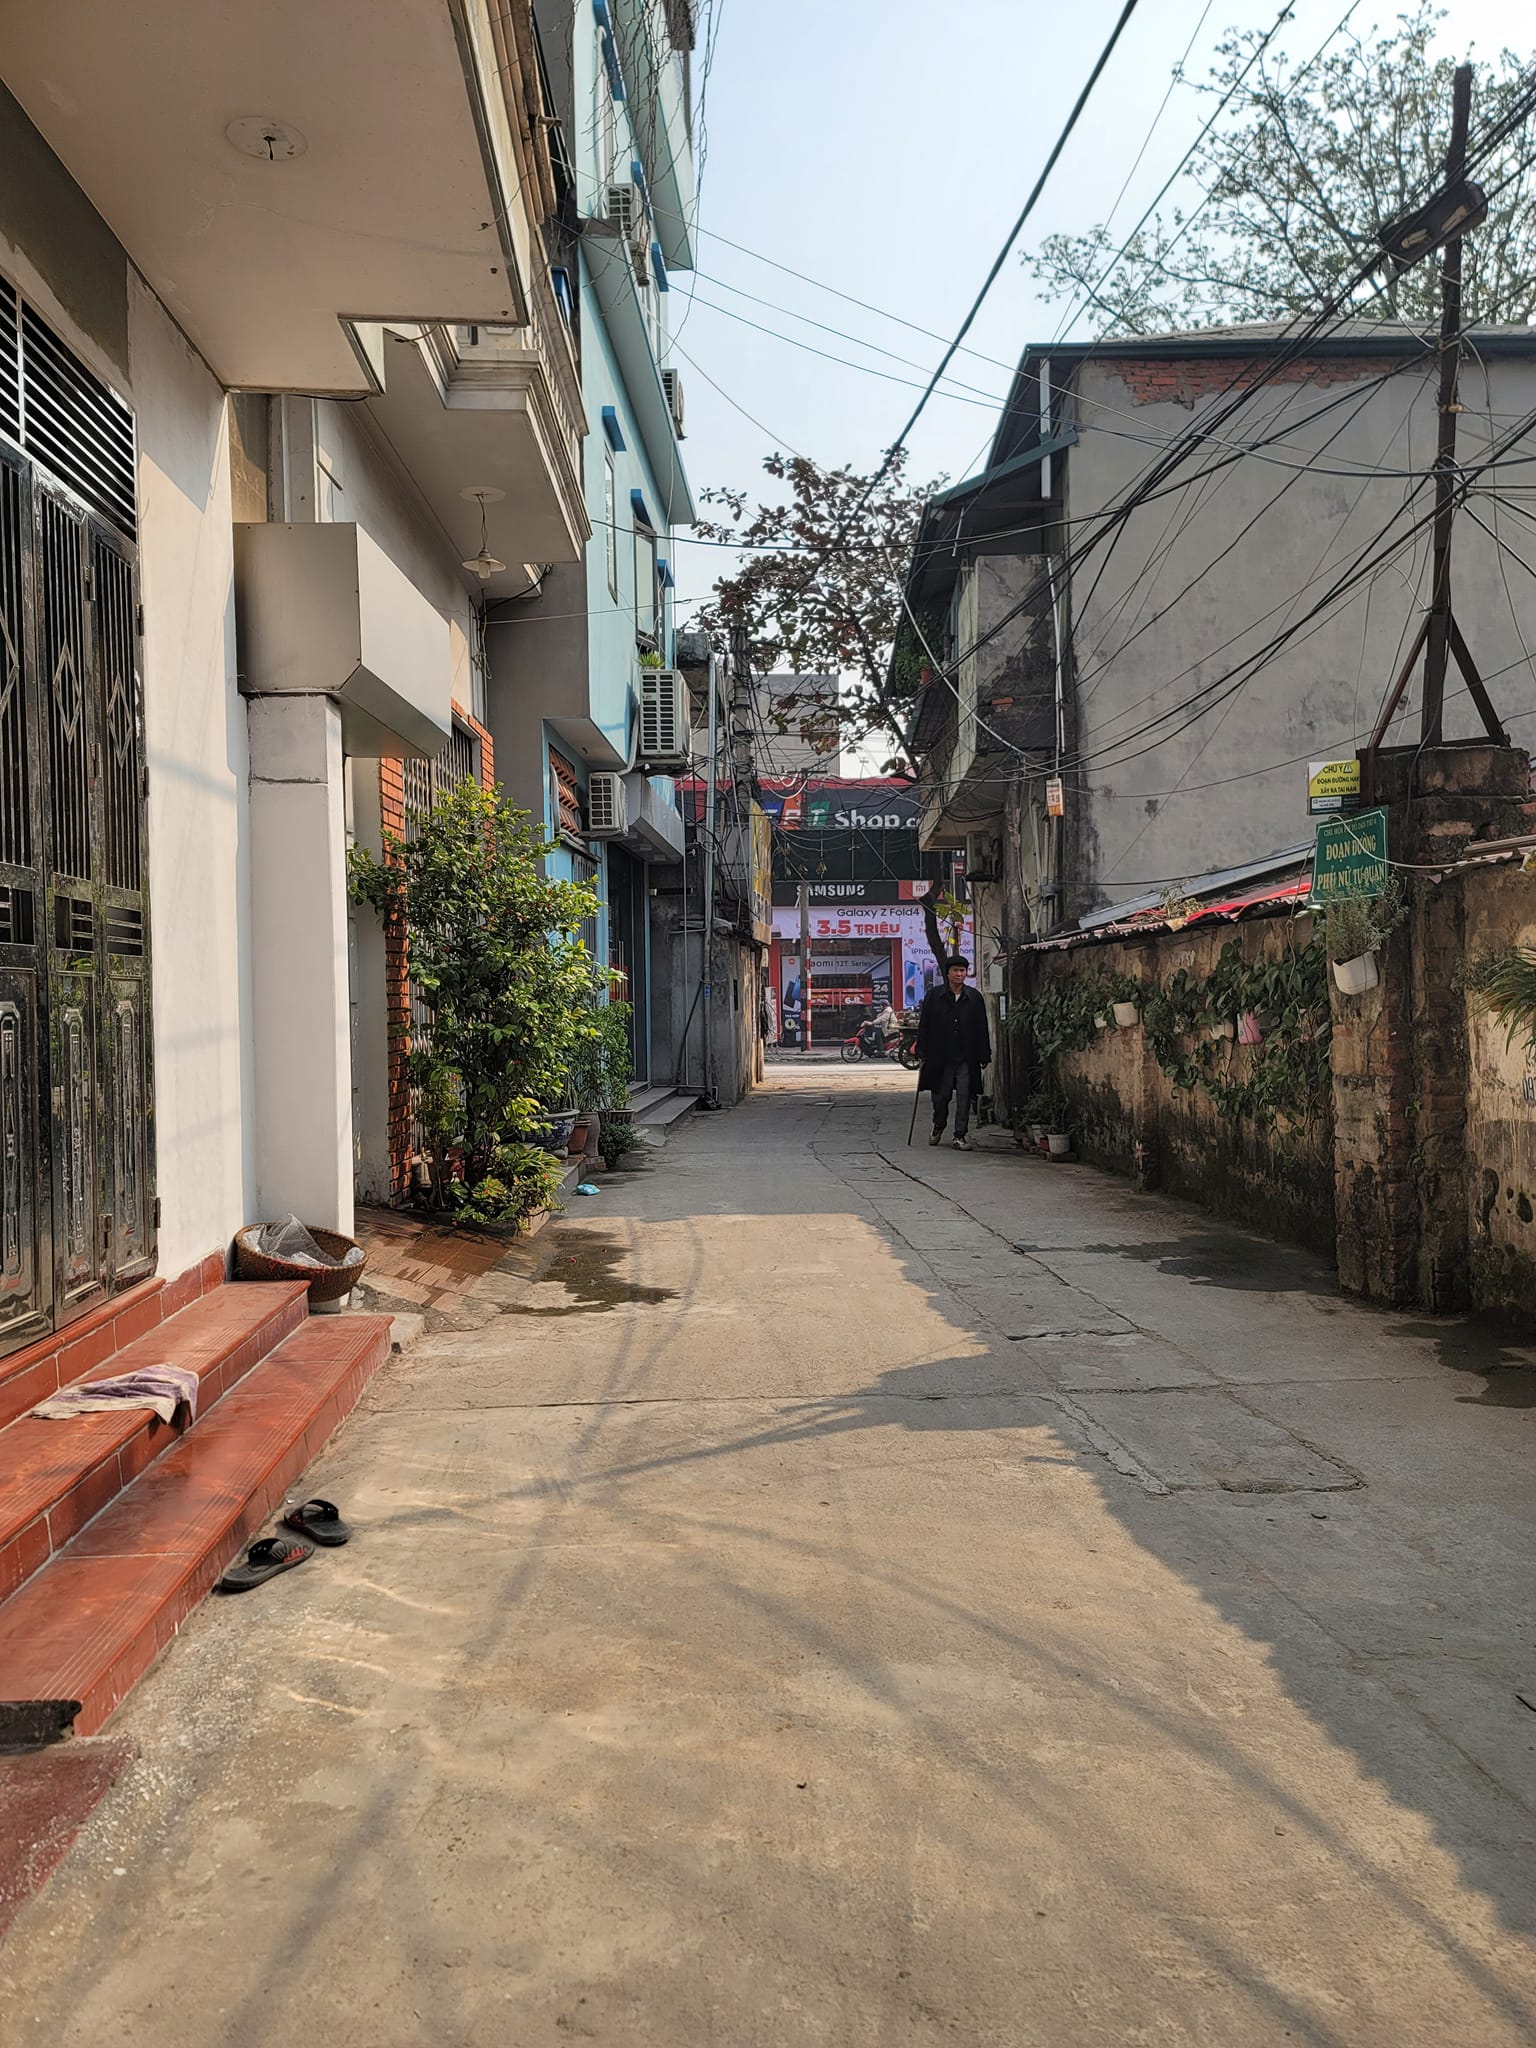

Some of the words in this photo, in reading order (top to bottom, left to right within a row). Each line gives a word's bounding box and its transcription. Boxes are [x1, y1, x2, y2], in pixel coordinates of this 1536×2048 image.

[1325, 840, 1351, 862] ĐOẠN
[796, 884, 866, 897] SAMSUNG
[836, 908, 876, 918] Galaxy
[880, 908, 887, 917] Z
[889, 907, 920, 917] Fold4
[816, 919, 851, 935] 3.5
[854, 921, 900, 937] TRIỆU
[811, 960, 833, 968] aomi
[873, 984, 889, 993] 24
